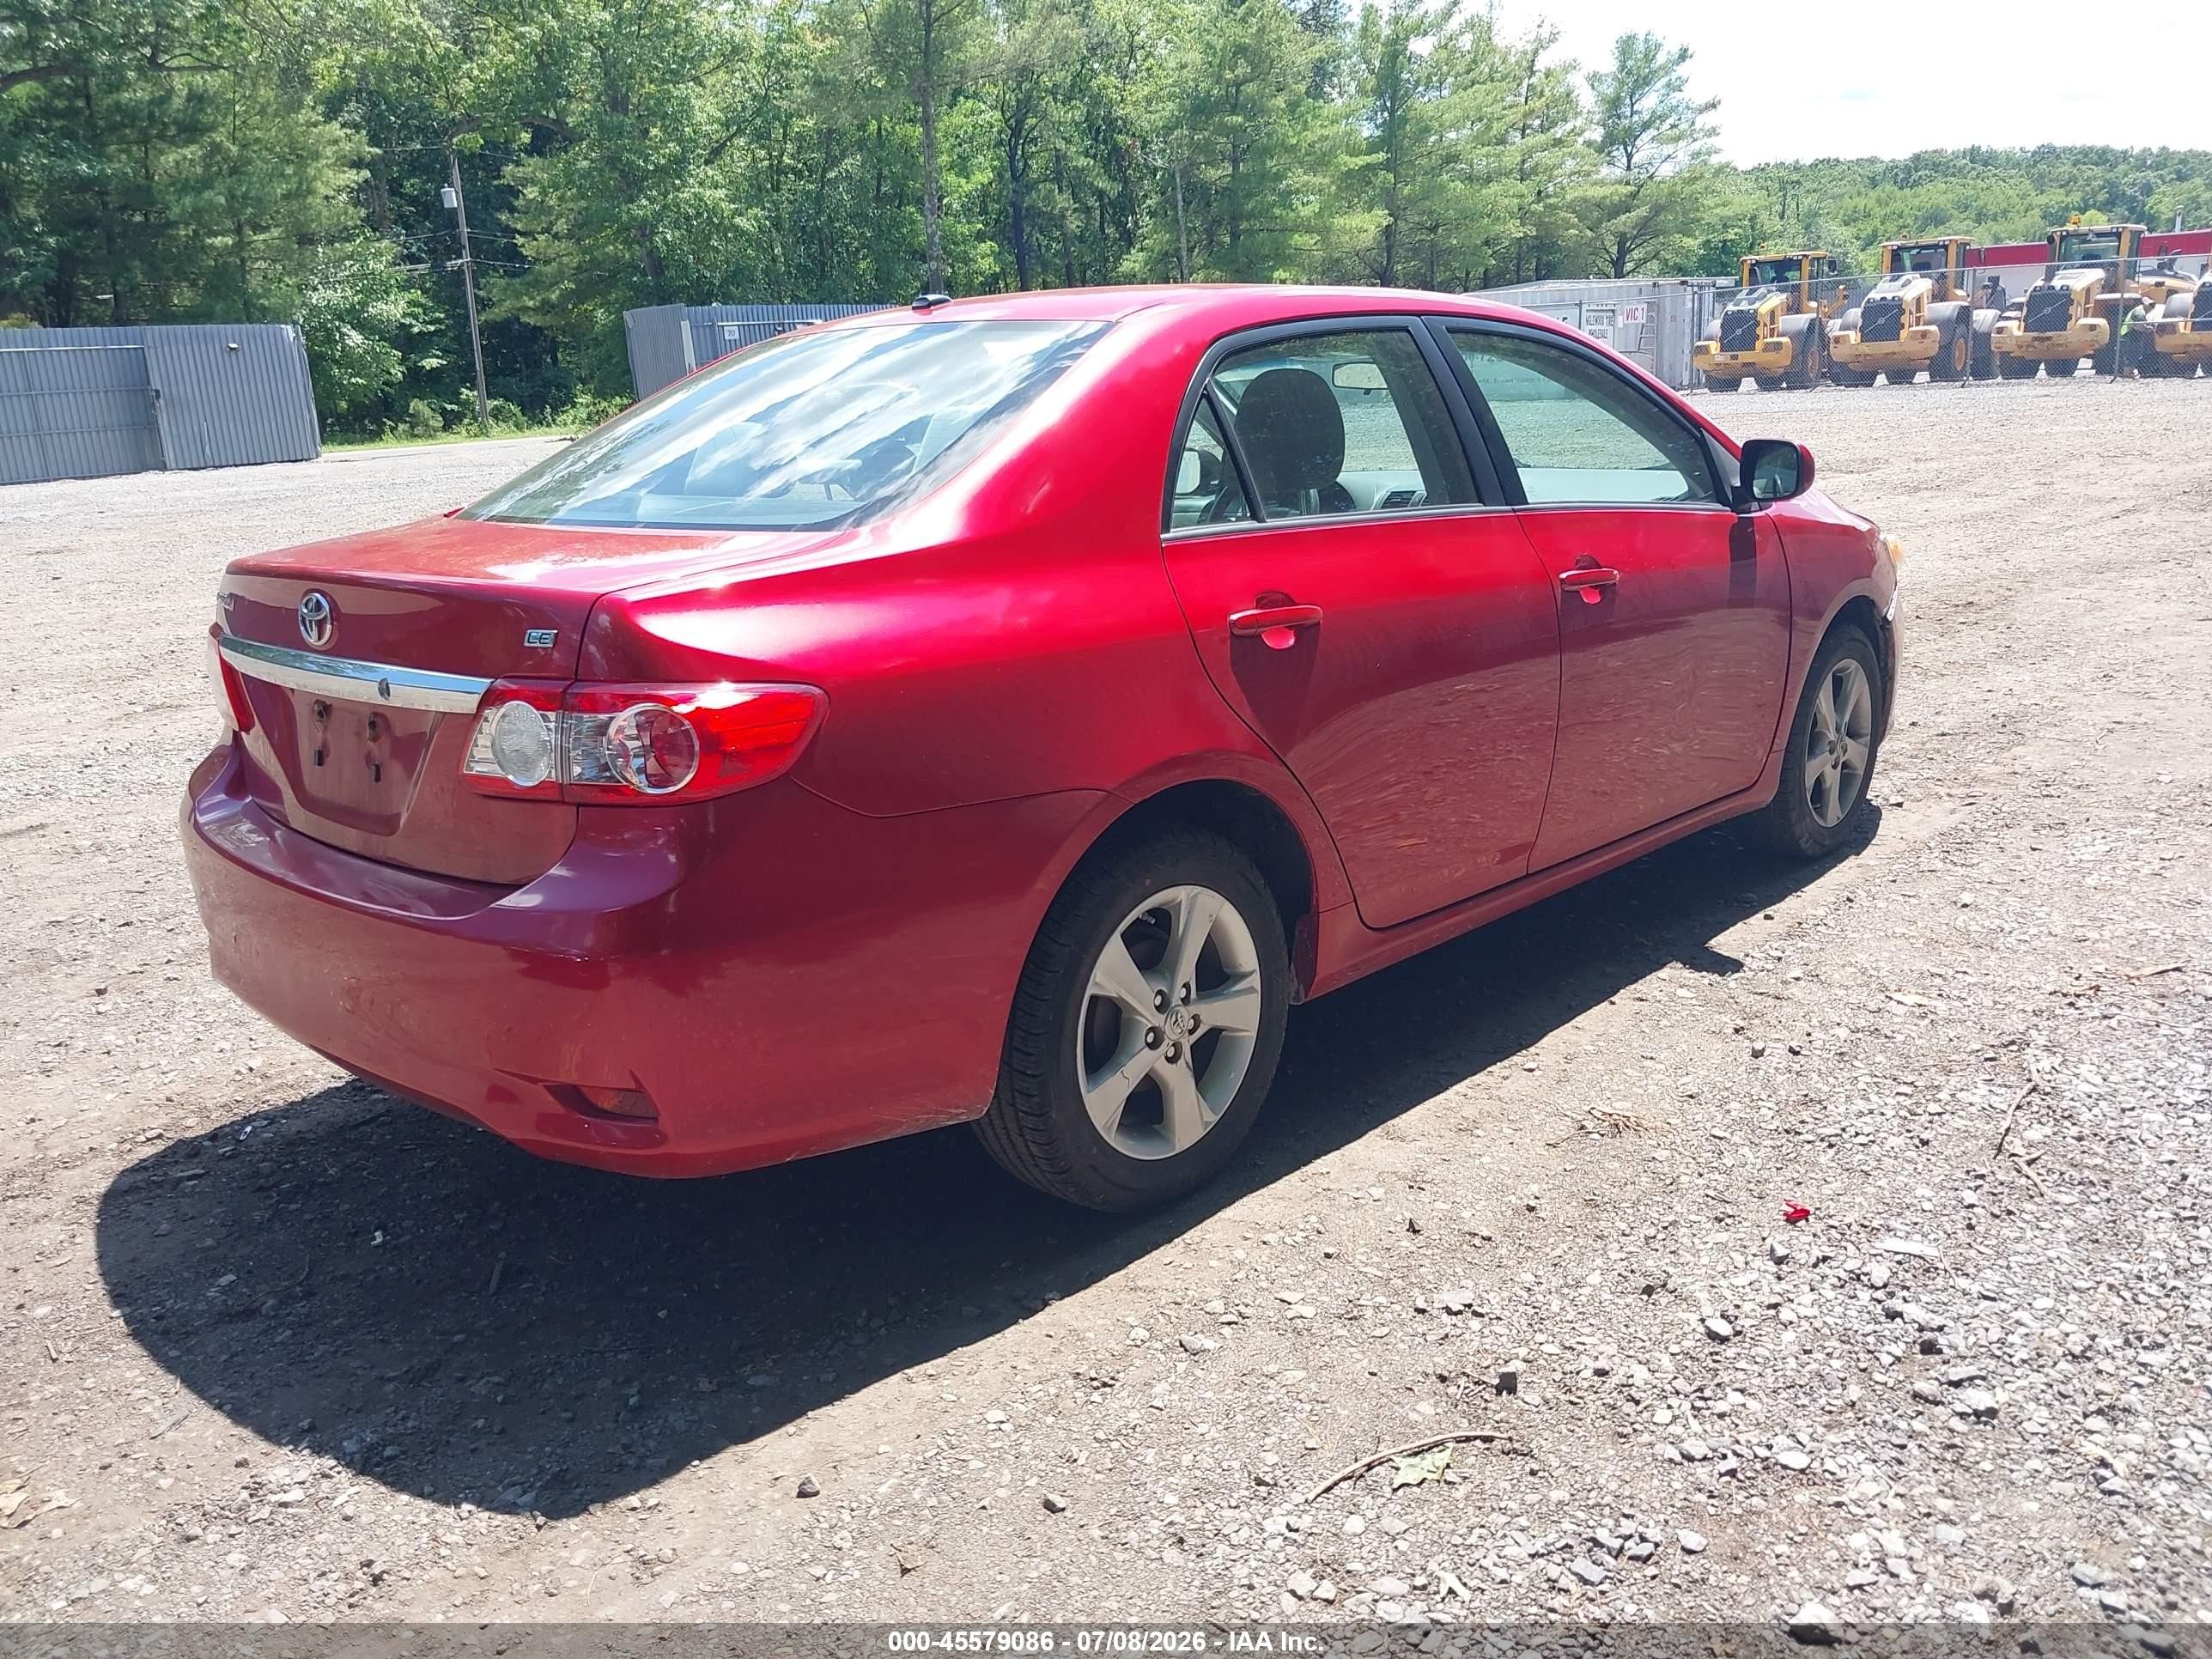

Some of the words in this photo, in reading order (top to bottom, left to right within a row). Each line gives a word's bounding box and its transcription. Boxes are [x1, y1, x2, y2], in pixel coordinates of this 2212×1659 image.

[1626, 307, 1638, 321] VIC
[1641, 307, 1645, 320] 1
[526, 631, 552, 645] LE
